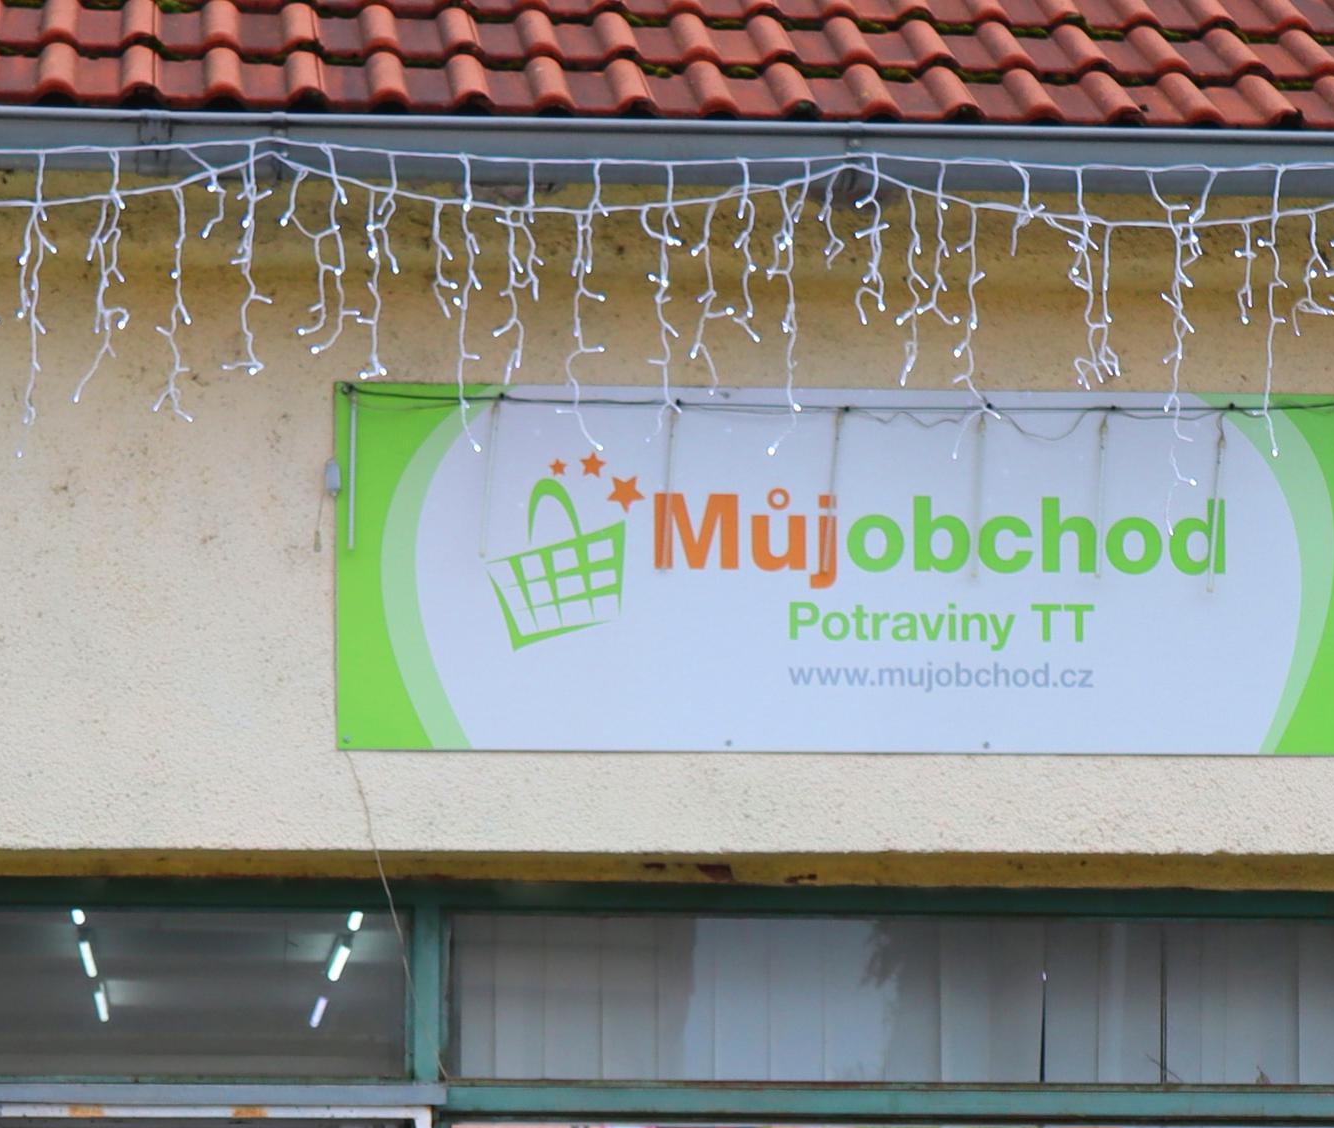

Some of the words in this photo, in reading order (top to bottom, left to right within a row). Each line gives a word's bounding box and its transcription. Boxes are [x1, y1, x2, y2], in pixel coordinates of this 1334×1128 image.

[652, 488, 1227, 589] Můjobchod
[788, 601, 1015, 653] Potraviny
[1029, 603, 1096, 643] TT
[788, 661, 1096, 693] www.mujobchod.cz
